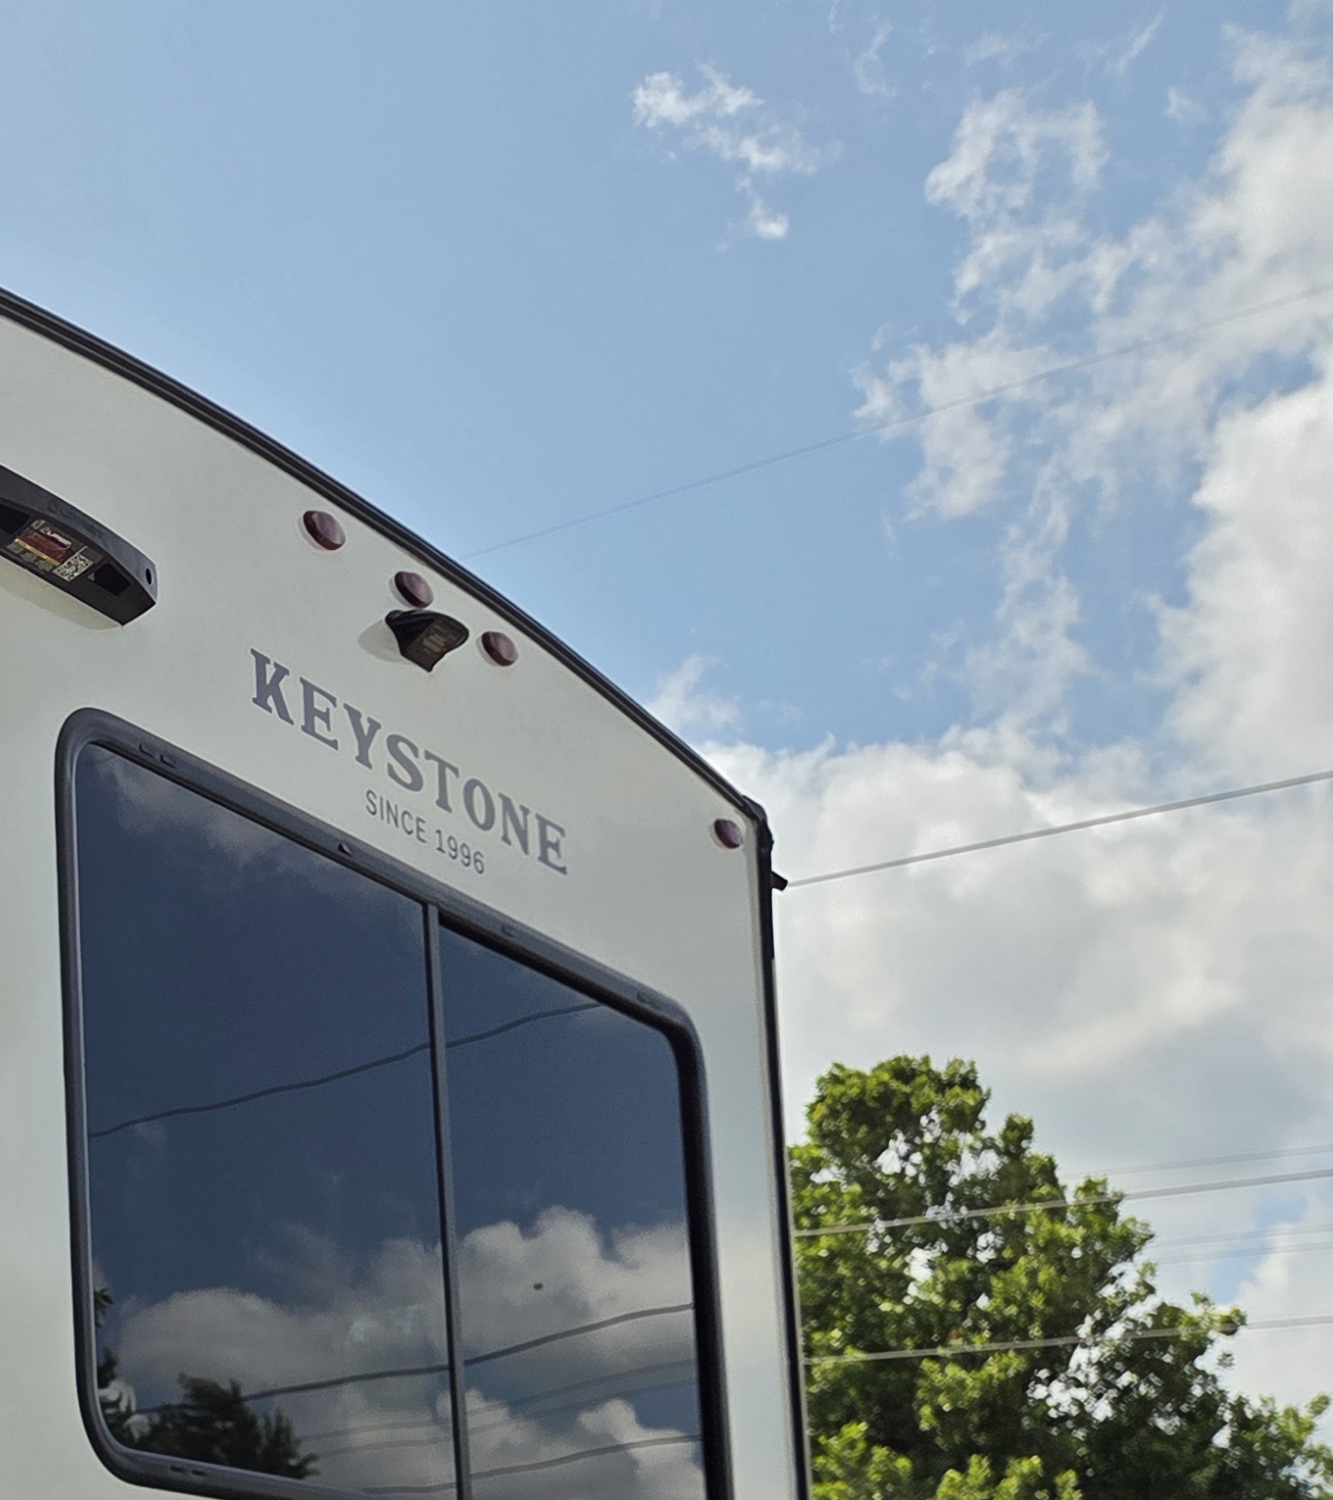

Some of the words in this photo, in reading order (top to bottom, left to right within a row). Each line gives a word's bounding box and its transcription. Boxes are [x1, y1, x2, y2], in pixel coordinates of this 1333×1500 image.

[250, 648, 568, 875] KEYSTONE
[364, 789, 427, 844] SINCE
[435, 829, 486, 875] 1996
